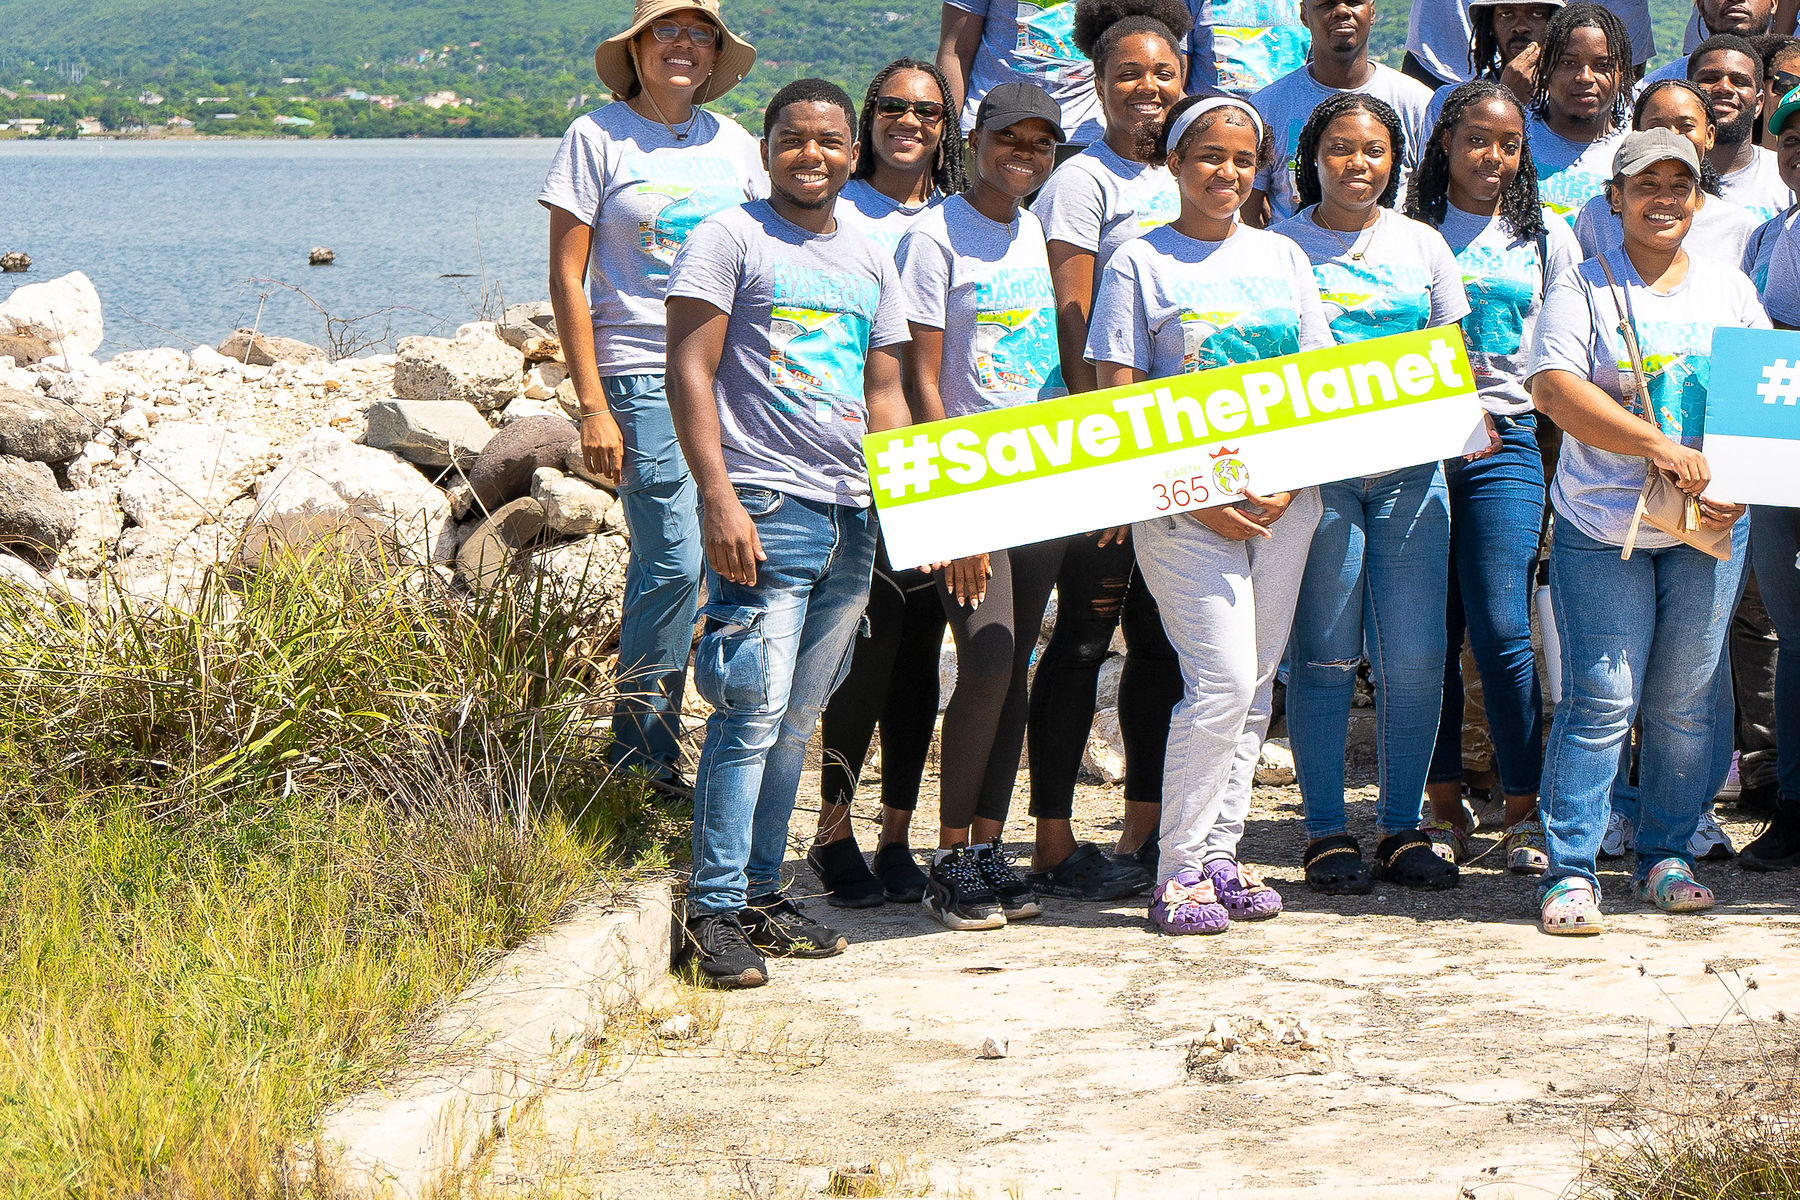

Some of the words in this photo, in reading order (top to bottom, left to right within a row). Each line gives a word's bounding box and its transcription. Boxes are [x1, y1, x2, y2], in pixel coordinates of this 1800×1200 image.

[976, 280, 1052, 303] HARBO
[876, 338, 1464, 499] #SaveThePlanet
[1152, 475, 1209, 511] 365
